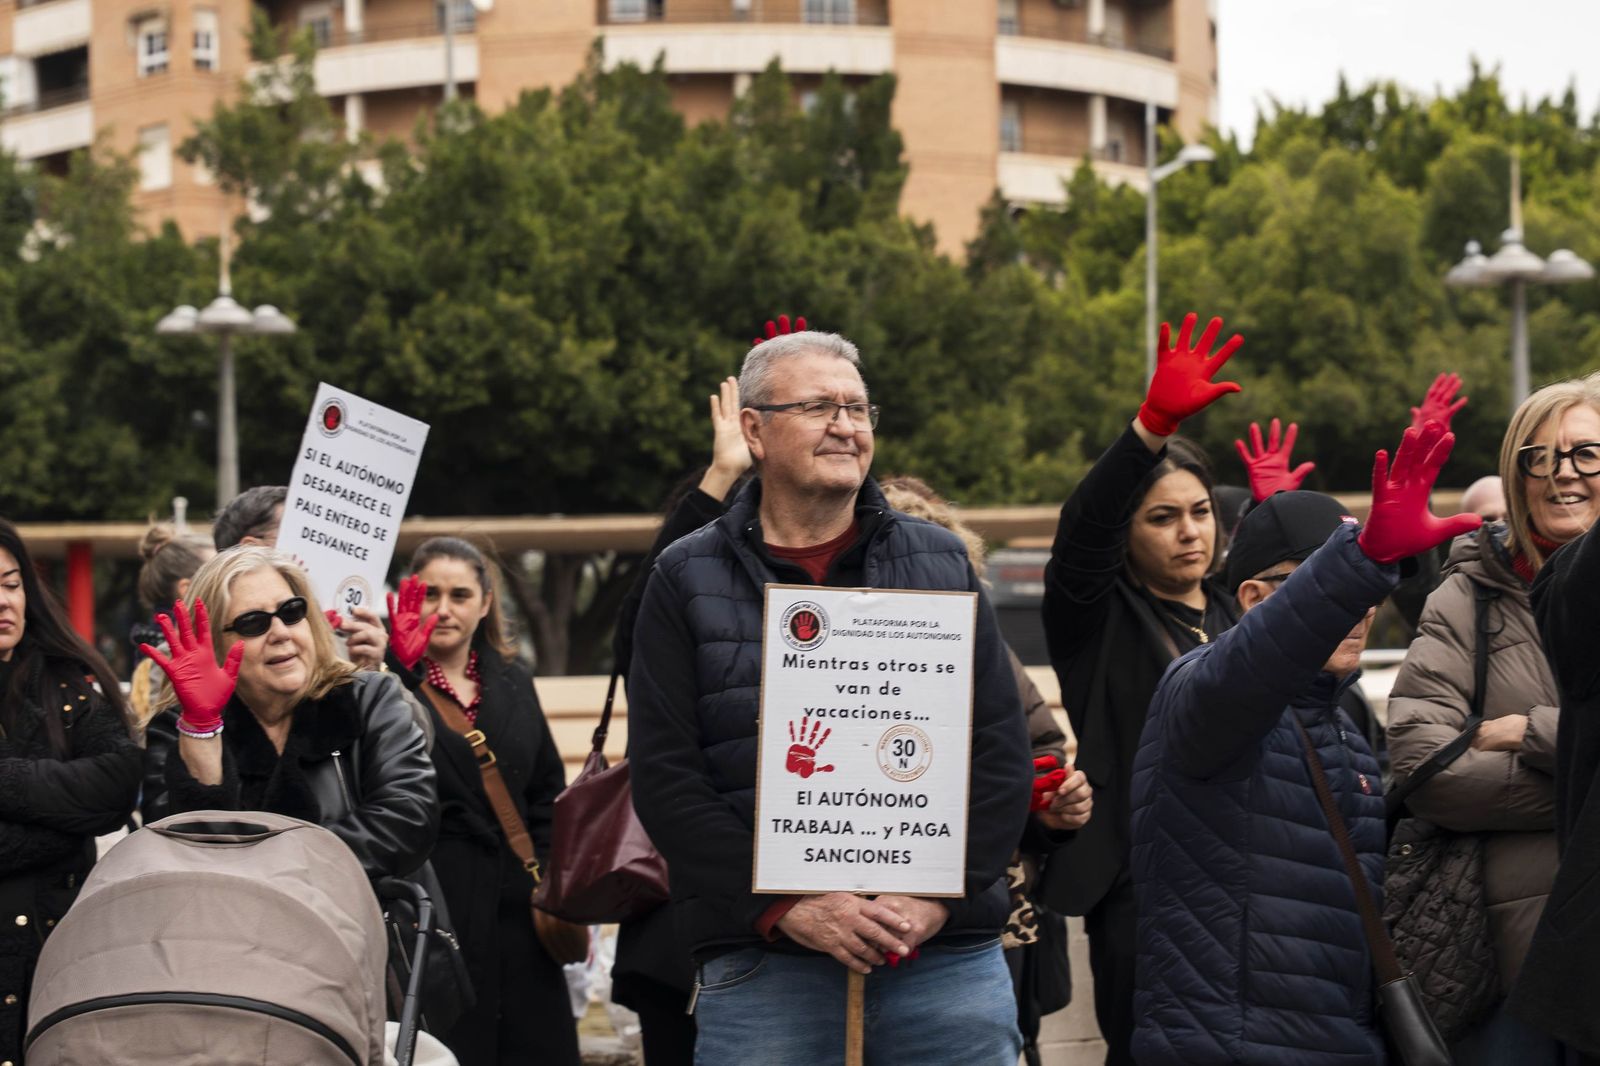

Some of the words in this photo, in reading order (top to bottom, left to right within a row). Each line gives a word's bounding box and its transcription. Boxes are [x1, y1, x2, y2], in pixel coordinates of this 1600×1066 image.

[304, 447, 318, 462] SI
[319, 453, 332, 468] EL
[335, 460, 405, 495] AUTÓNOMO
[302, 473, 378, 511] DESAPARECE
[379, 502, 392, 517] EL
[295, 497, 322, 517] PAIS
[325, 509, 370, 535] ENTERO
[372, 527, 388, 541] SE
[301, 526, 369, 561] DESVANECE
[345, 588, 362, 605] 30
[852, 618, 908, 628] PLATAFORMA
[911, 620, 927, 628] POR
[929, 621, 940, 629] LA
[832, 629, 874, 638] DIGNIDAD
[876, 630, 887, 639] DE
[889, 631, 905, 639] LOS
[906, 632, 962, 641] AUTONOMOS
[783, 653, 869, 671] Mientras
[878, 659, 928, 673] otros
[935, 664, 956, 674] se
[835, 684, 870, 695] van
[879, 680, 902, 696] de
[804, 705, 930, 721] vacaciones...
[893, 738, 915, 757] 30
[899, 758, 908, 769] N
[797, 790, 812, 805] El
[818, 788, 928, 809] AUTÓNOMO
[772, 818, 854, 835] TRABAJA
[883, 826, 894, 840] y
[899, 822, 951, 837] PAGA
[804, 848, 912, 865] SANCIONES
